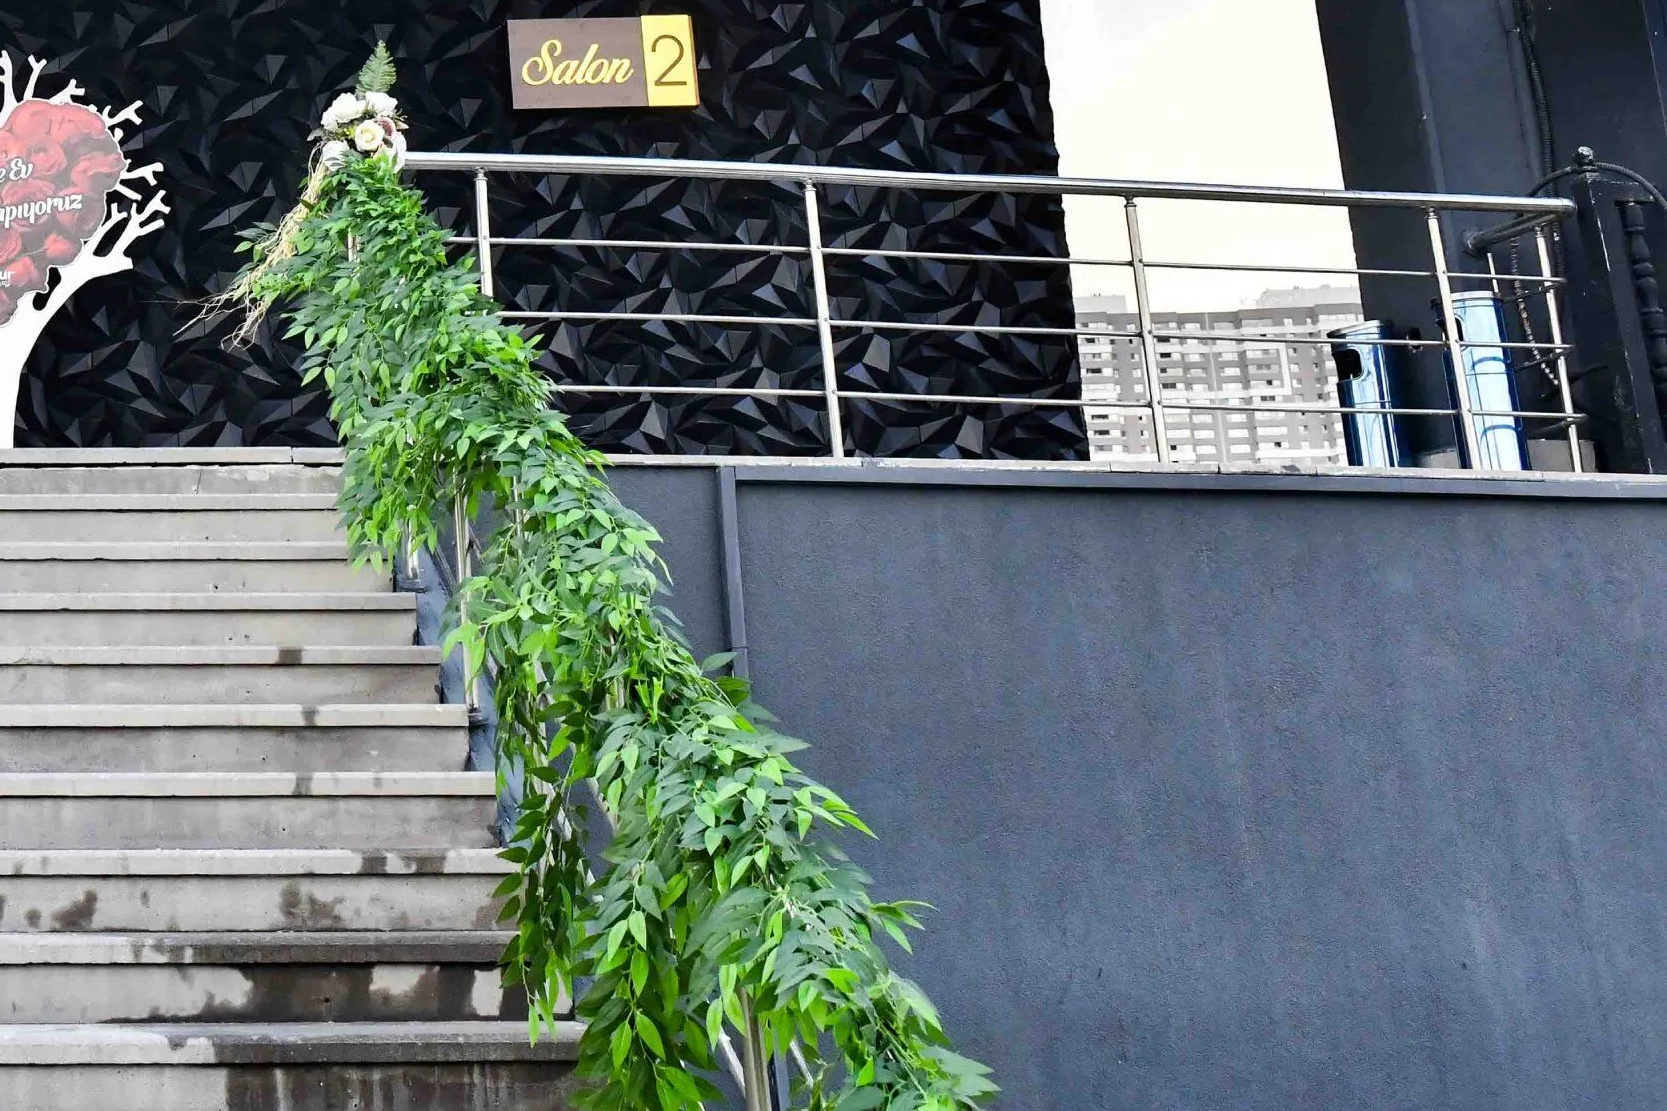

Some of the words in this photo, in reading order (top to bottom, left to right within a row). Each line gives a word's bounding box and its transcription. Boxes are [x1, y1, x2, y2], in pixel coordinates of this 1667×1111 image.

[521, 39, 634, 86] Salon
[651, 34, 687, 86] 2
[9, 158, 34, 181] Ev
